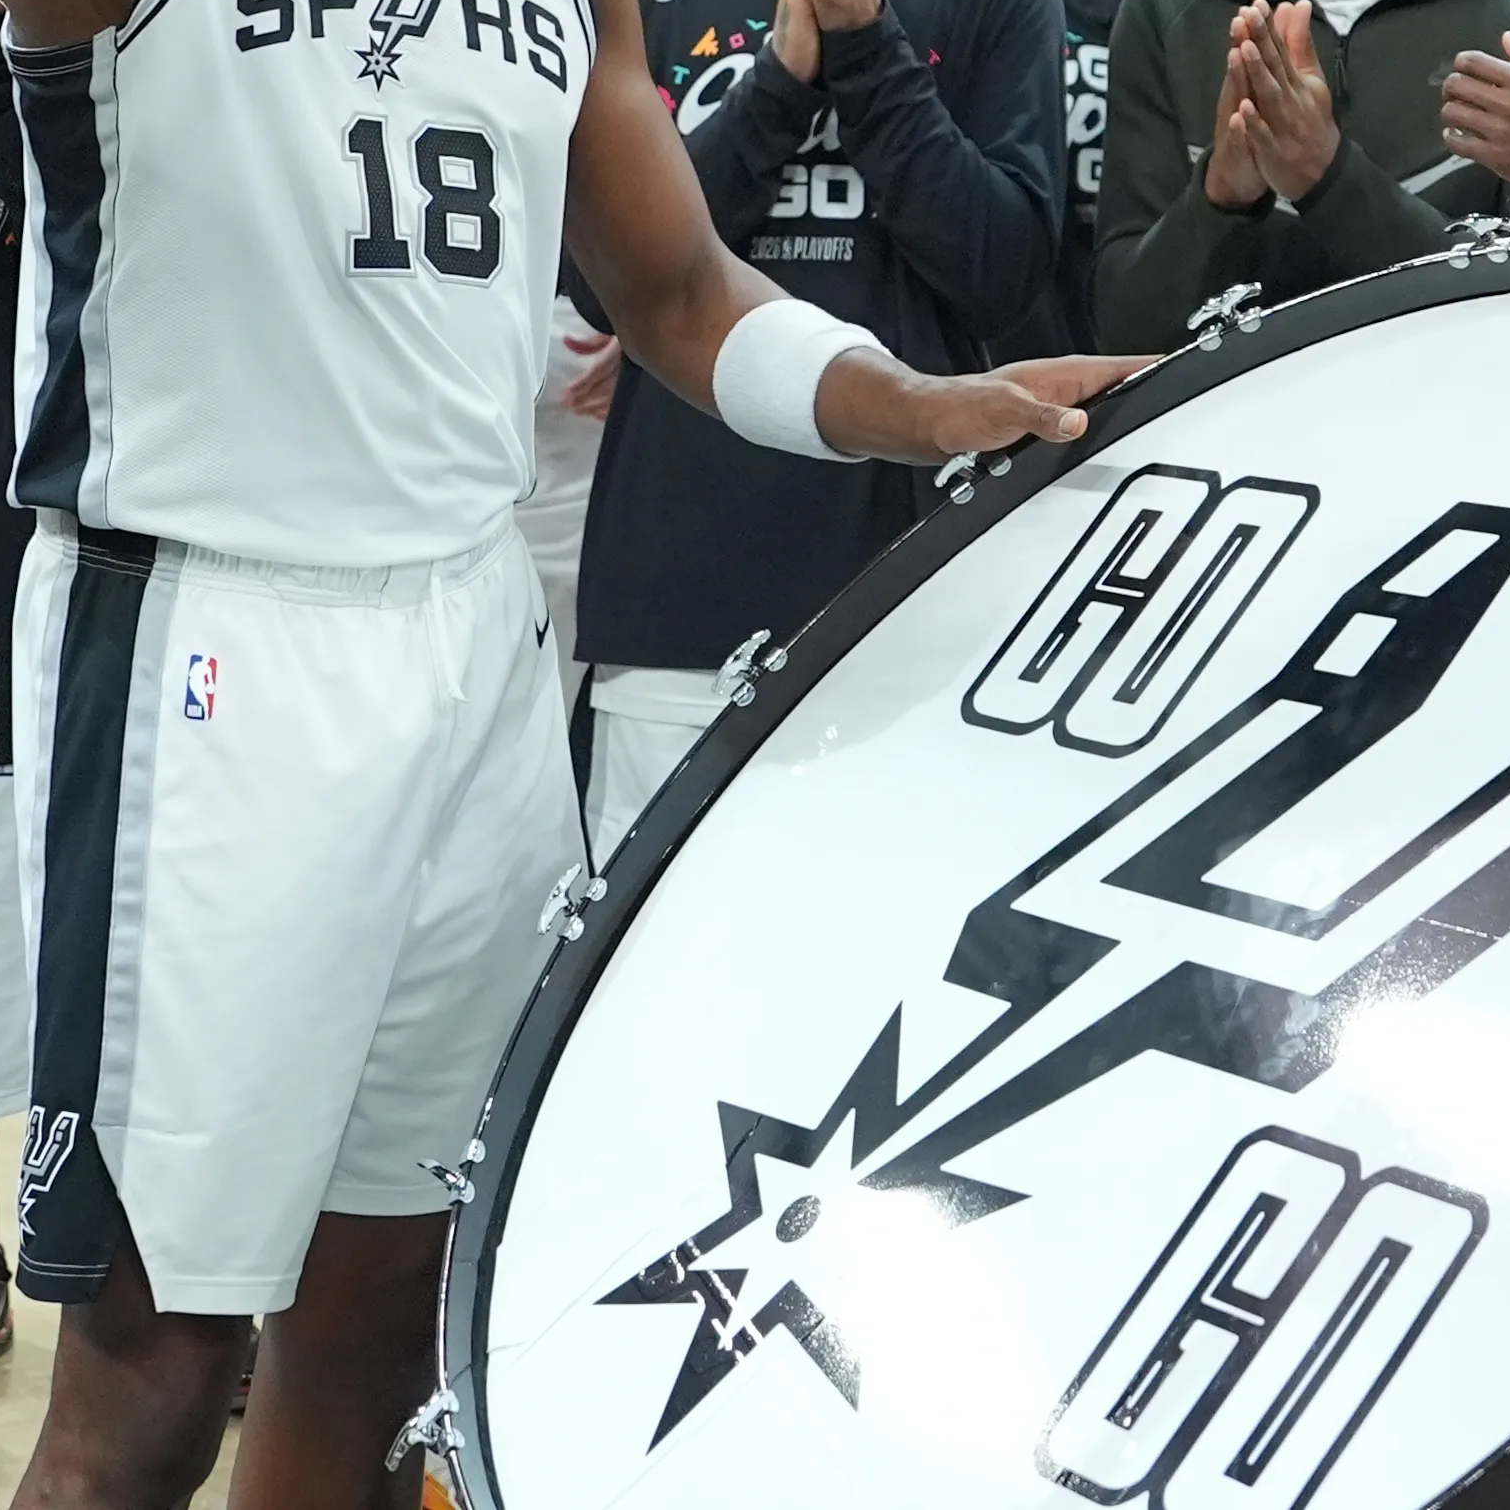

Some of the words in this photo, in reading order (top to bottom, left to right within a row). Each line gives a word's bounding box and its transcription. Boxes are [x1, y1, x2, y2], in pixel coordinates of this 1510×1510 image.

[341, 113, 505, 287] 18
[793, 236, 854, 262] PLAYOFFS
[961, 462, 1320, 757] GO
[1034, 1125, 1490, 1510] GO
